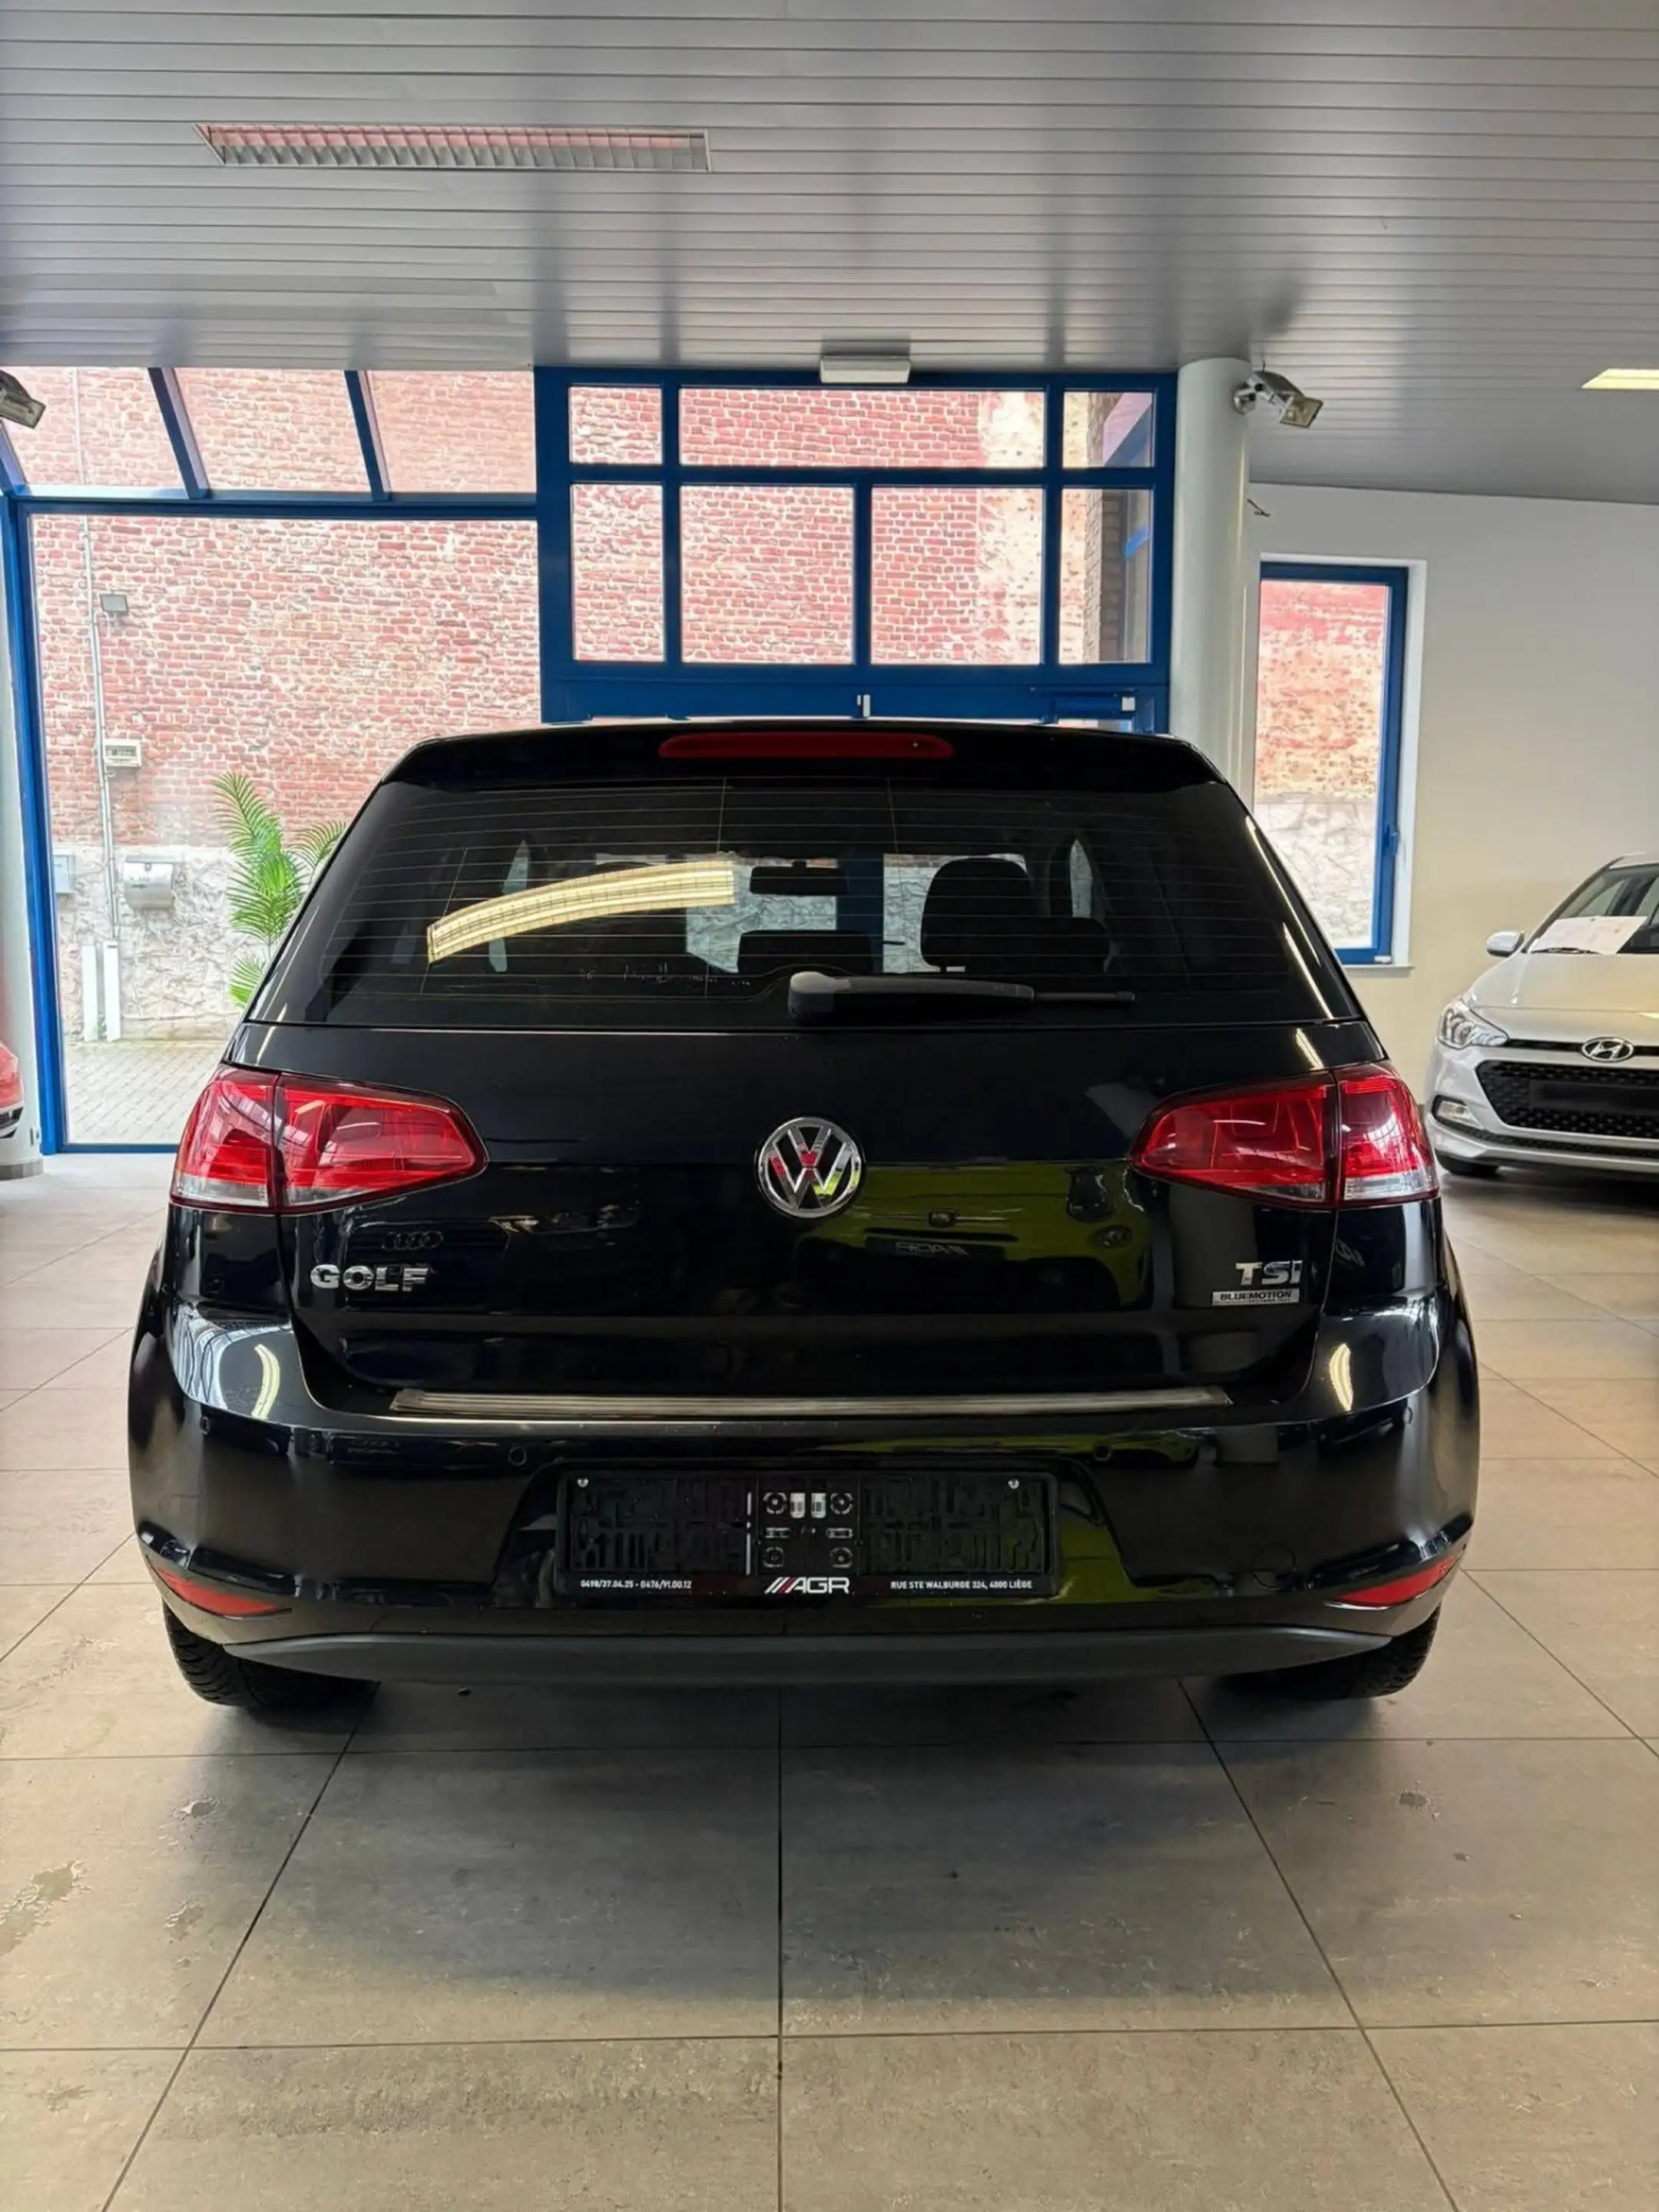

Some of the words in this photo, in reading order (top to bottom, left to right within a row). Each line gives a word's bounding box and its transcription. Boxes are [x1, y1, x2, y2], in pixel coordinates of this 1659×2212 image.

[310, 1263, 429, 1292] GOLF
[1235, 1260, 1303, 1286] TSI
[1220, 1290, 1292, 1300] BLUEMOTION
[890, 1580, 908, 1589] RUE
[909, 1580, 924, 1589] STE
[925, 1580, 971, 1589] WALBURGE
[988, 1580, 1008, 1589] 4000
[1008, 1578, 1032, 1589] LIÈGE
